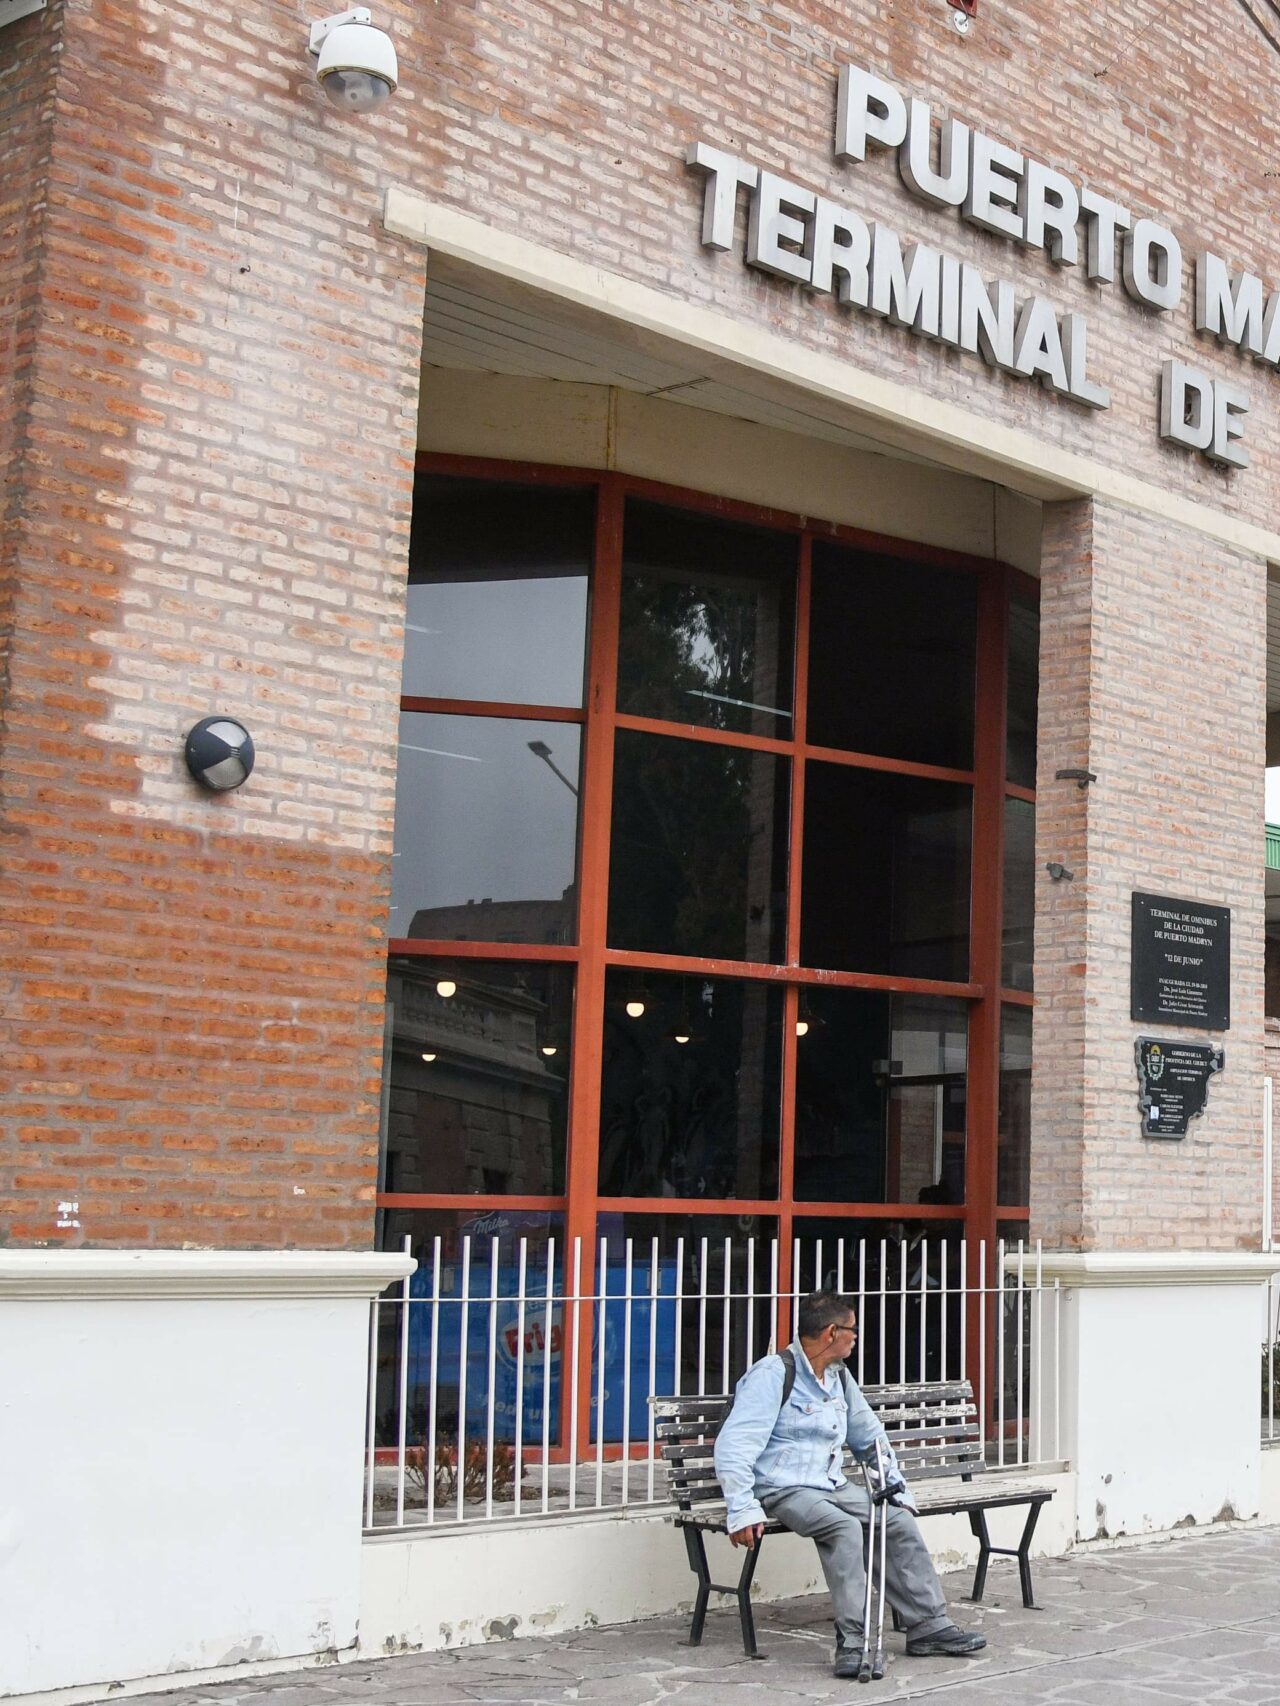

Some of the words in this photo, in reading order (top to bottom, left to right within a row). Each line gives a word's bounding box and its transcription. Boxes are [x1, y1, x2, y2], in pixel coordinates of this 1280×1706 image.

[835, 63, 1182, 311] PUERTO
[686, 141, 1109, 410] TERMINAL
[1160, 359, 1249, 469] DE
[1150, 908, 1181, 920] TERMINAL
[1182, 914, 1190, 922] DE
[1191, 916, 1217, 926] OMNIBUS
[1173, 923, 1181, 931] LA
[1182, 925, 1204, 934] CIUDAD
[1154, 931, 1163, 939] DE
[1164, 932, 1187, 942] PUERTO
[1188, 936, 1213, 946] MADRYN
[1174, 955, 1183, 963] DE
[473, 1216, 509, 1234] Milka
[504, 1322, 562, 1358] Frig
